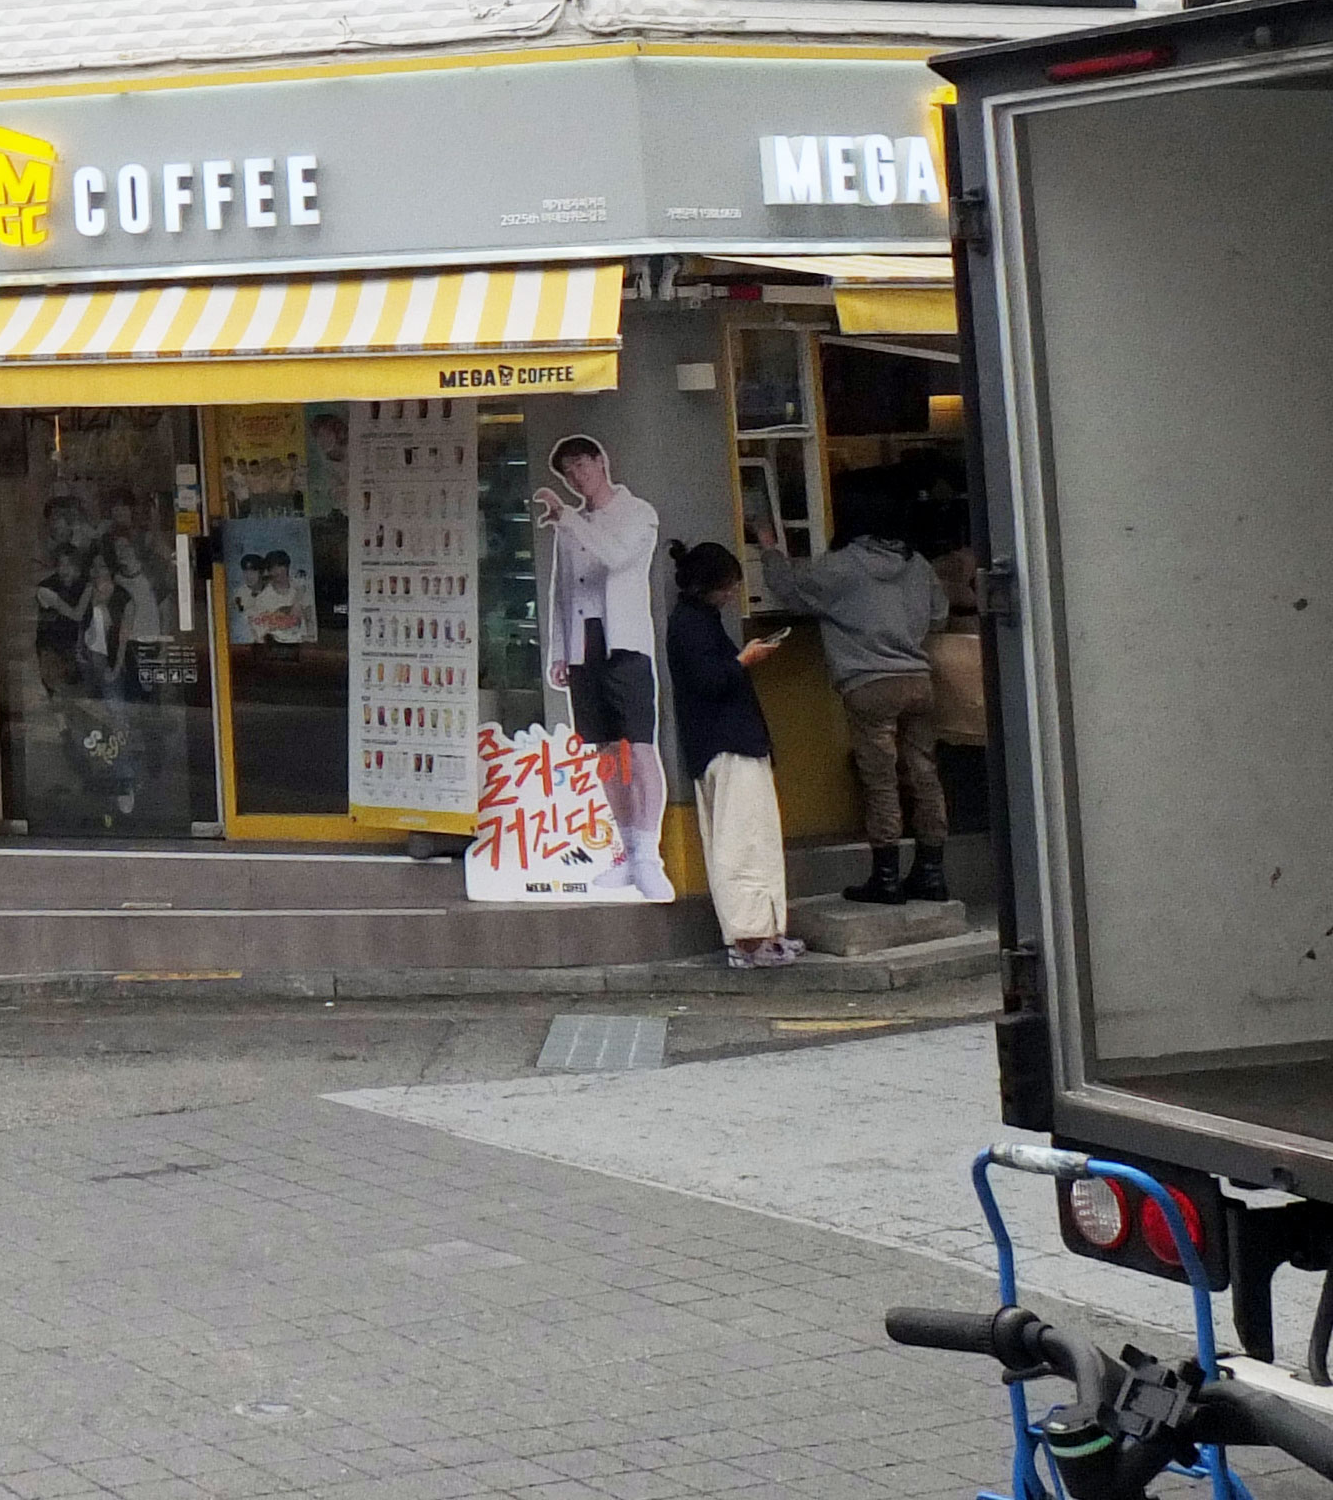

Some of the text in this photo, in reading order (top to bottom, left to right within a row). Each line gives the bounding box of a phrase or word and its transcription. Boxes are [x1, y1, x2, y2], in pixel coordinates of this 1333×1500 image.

[73, 153, 321, 237] COFFEE
[759, 134, 942, 206] MEGA
[439, 366, 575, 388] MEGA COFFEE
